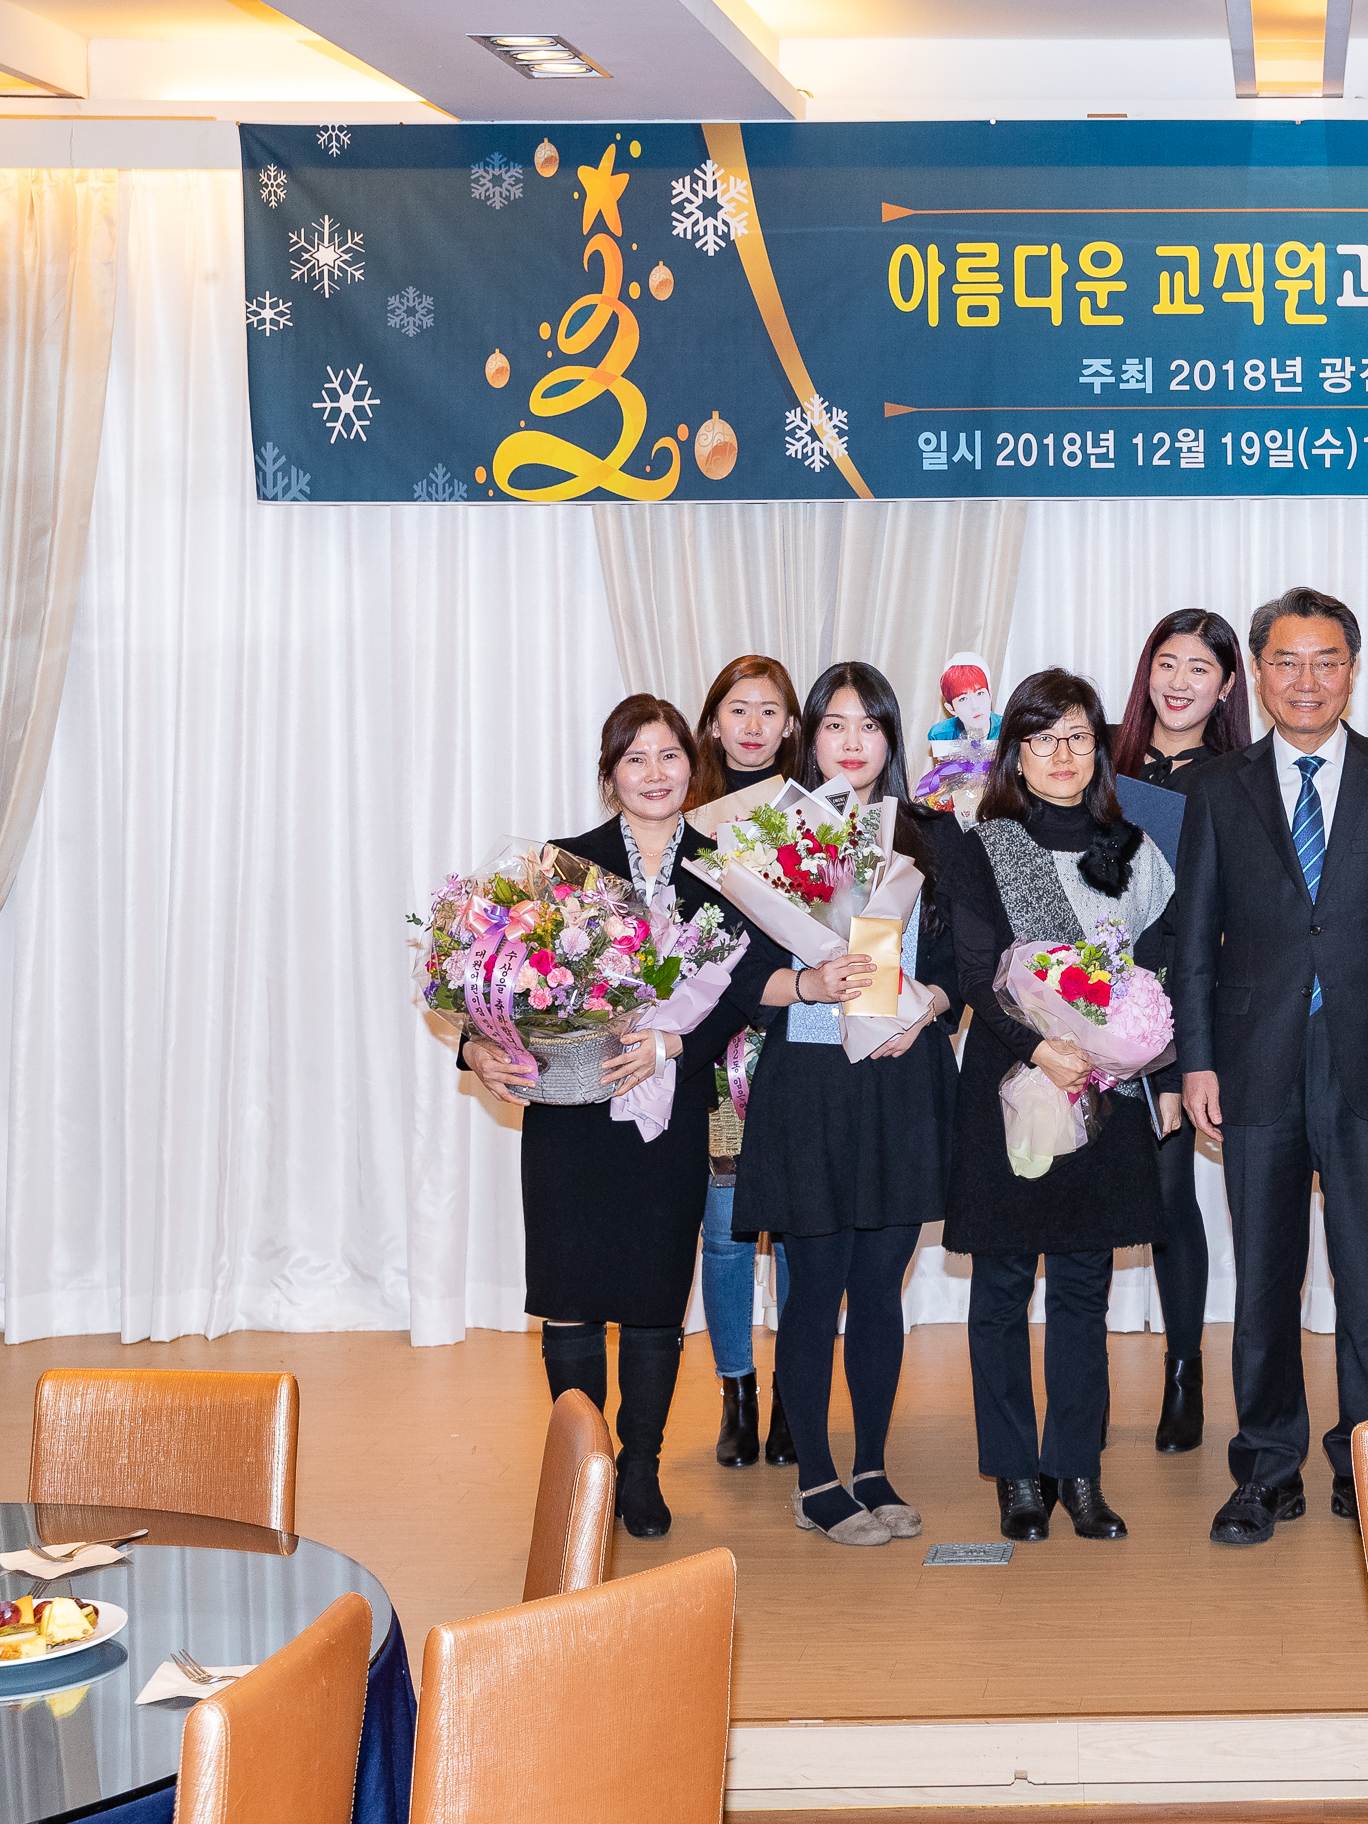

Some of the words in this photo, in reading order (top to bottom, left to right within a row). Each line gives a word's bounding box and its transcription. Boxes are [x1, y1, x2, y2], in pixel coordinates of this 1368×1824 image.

[888, 240, 1128, 328] 아름다운
[1078, 357, 1154, 394] 주최
[1169, 356, 1303, 393] 2018년
[917, 430, 982, 471] 일시
[996, 429, 1116, 469] 2018년
[1132, 428, 1205, 469] 12월
[495, 949, 519, 995] 수상을
